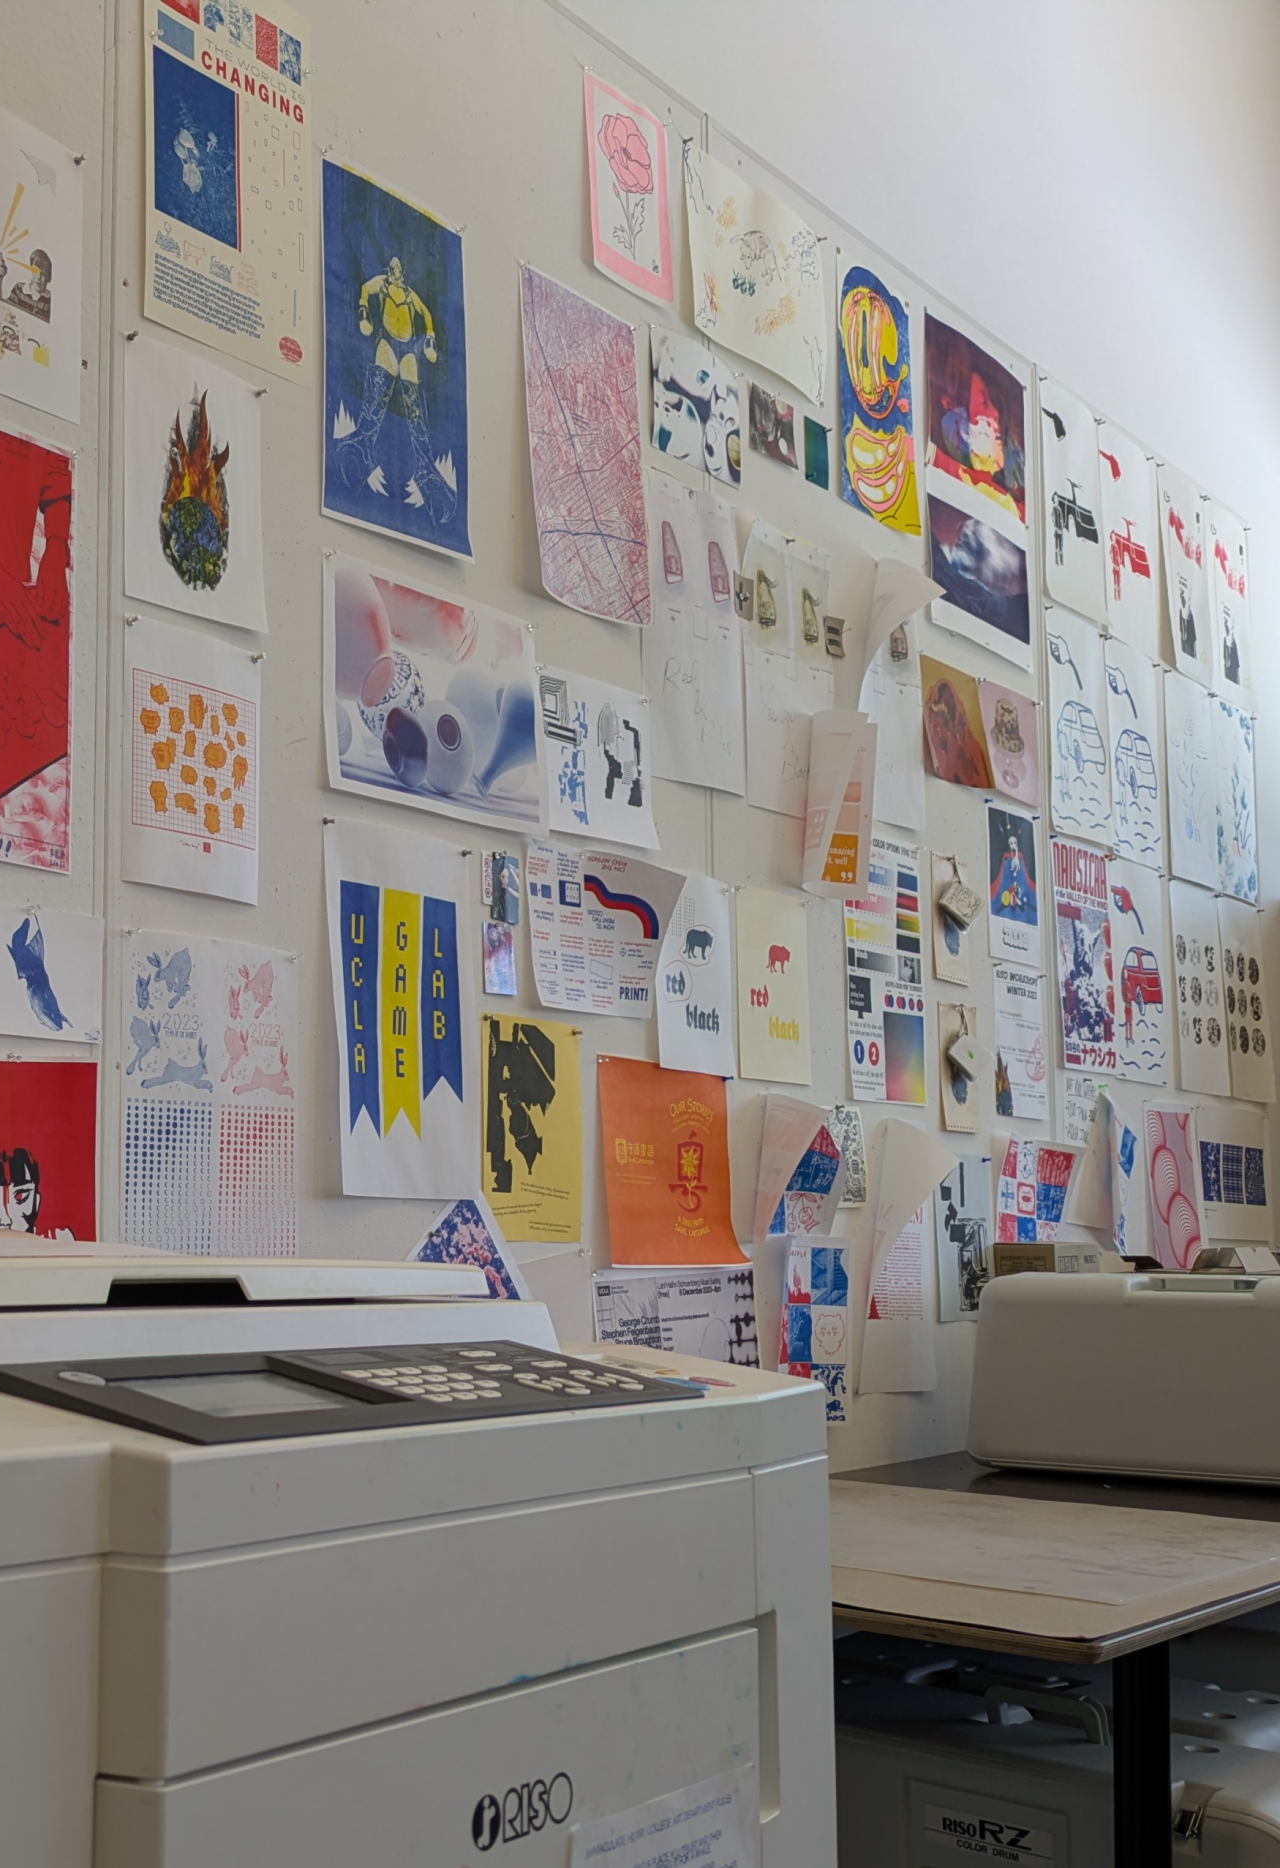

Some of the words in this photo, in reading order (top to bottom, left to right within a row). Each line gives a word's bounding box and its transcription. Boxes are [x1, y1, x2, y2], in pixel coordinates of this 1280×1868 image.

[205, 38, 233, 62] THE
[237, 57, 287, 93] WORLD
[291, 88, 306, 105] IS
[201, 50, 304, 124] CHANGING
[829, 847, 855, 857] amazing
[835, 857, 848, 865] well
[601, 864, 614, 872] THE
[611, 859, 628, 868] RISO
[614, 864, 626, 873] ON
[433, 928, 446, 1040] LAB
[665, 970, 686, 996] red
[996, 968, 1008, 980] RISO
[1009, 971, 1038, 987] WORKSHOPS
[350, 913, 366, 1074] UCLA
[392, 921, 408, 1078] GAME
[619, 985, 648, 1002] PRINT!
[750, 983, 769, 1009] red
[1006, 985, 1027, 998] WINTER
[162, 1012, 200, 1031] 2023
[685, 1002, 720, 1036] black
[768, 1014, 800, 1044] black
[249, 1023, 281, 1040] 2023
[1081, 1044, 1116, 1069] ナウシカ
[669, 1100, 687, 1117] OUR
[686, 1097, 714, 1122] STORIES
[683, 1288, 703, 1297] December
[619, 1317, 641, 1328] George
[641, 1315, 660, 1325] Crumb
[601, 1328, 627, 1340] Stephen
[627, 1326, 660, 1337] Feigenbaum
[633, 1336, 661, 1346] Broughton
[503, 1771, 574, 1843] RISO
[942, 1816, 977, 1838] RISO
[979, 1818, 1032, 1851] RZ
[956, 1839, 987, 1854] COLOR
[992, 1848, 1019, 1862] DRUM
